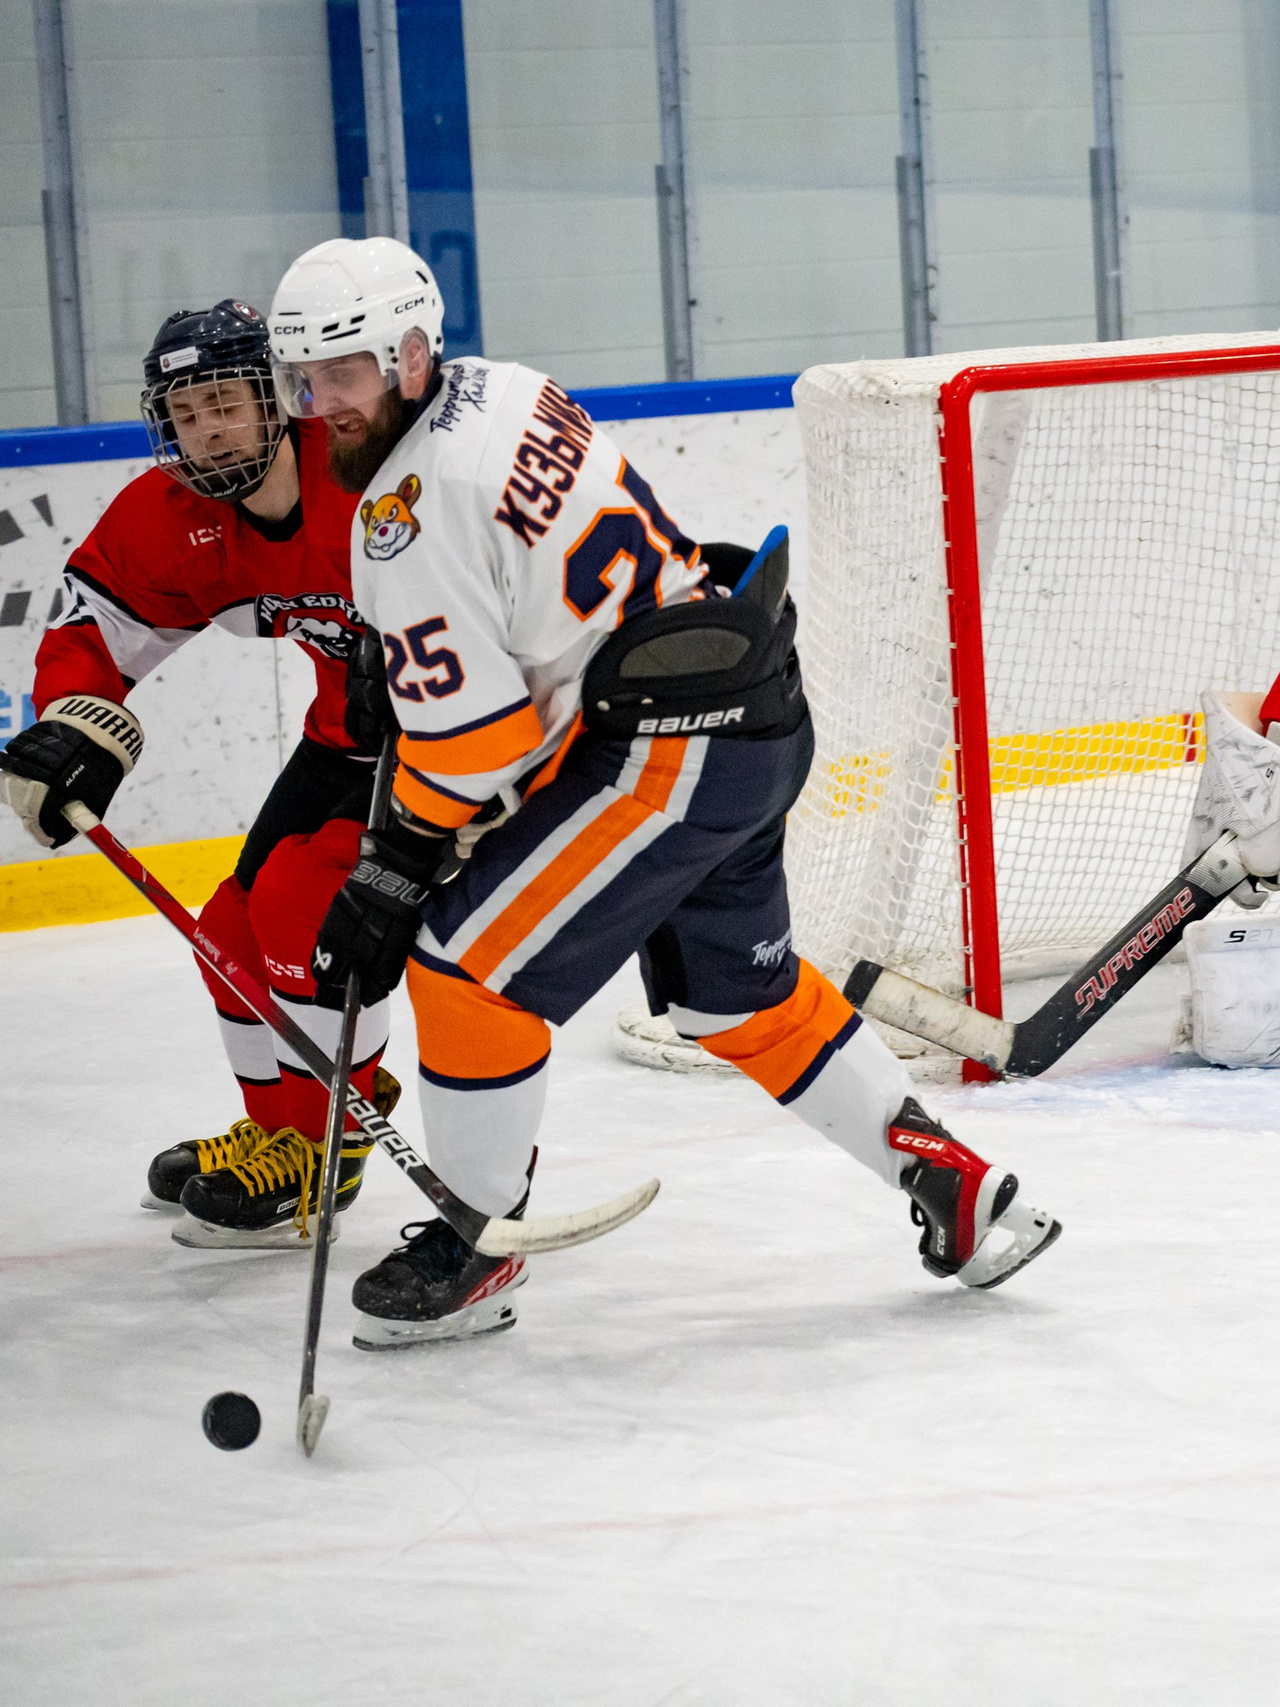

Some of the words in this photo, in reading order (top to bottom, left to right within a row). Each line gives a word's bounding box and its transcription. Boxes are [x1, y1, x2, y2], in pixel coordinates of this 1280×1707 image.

[395, 296, 425, 315] CCM
[274, 325, 306, 336] CCM
[383, 614, 466, 704] 25
[56, 698, 145, 766] WARRI
[637, 706, 745, 735] BAUER
[1073, 885, 1197, 1023] SUPREME
[896, 1133, 946, 1152] CCM
[936, 1225, 946, 1256] CCM
